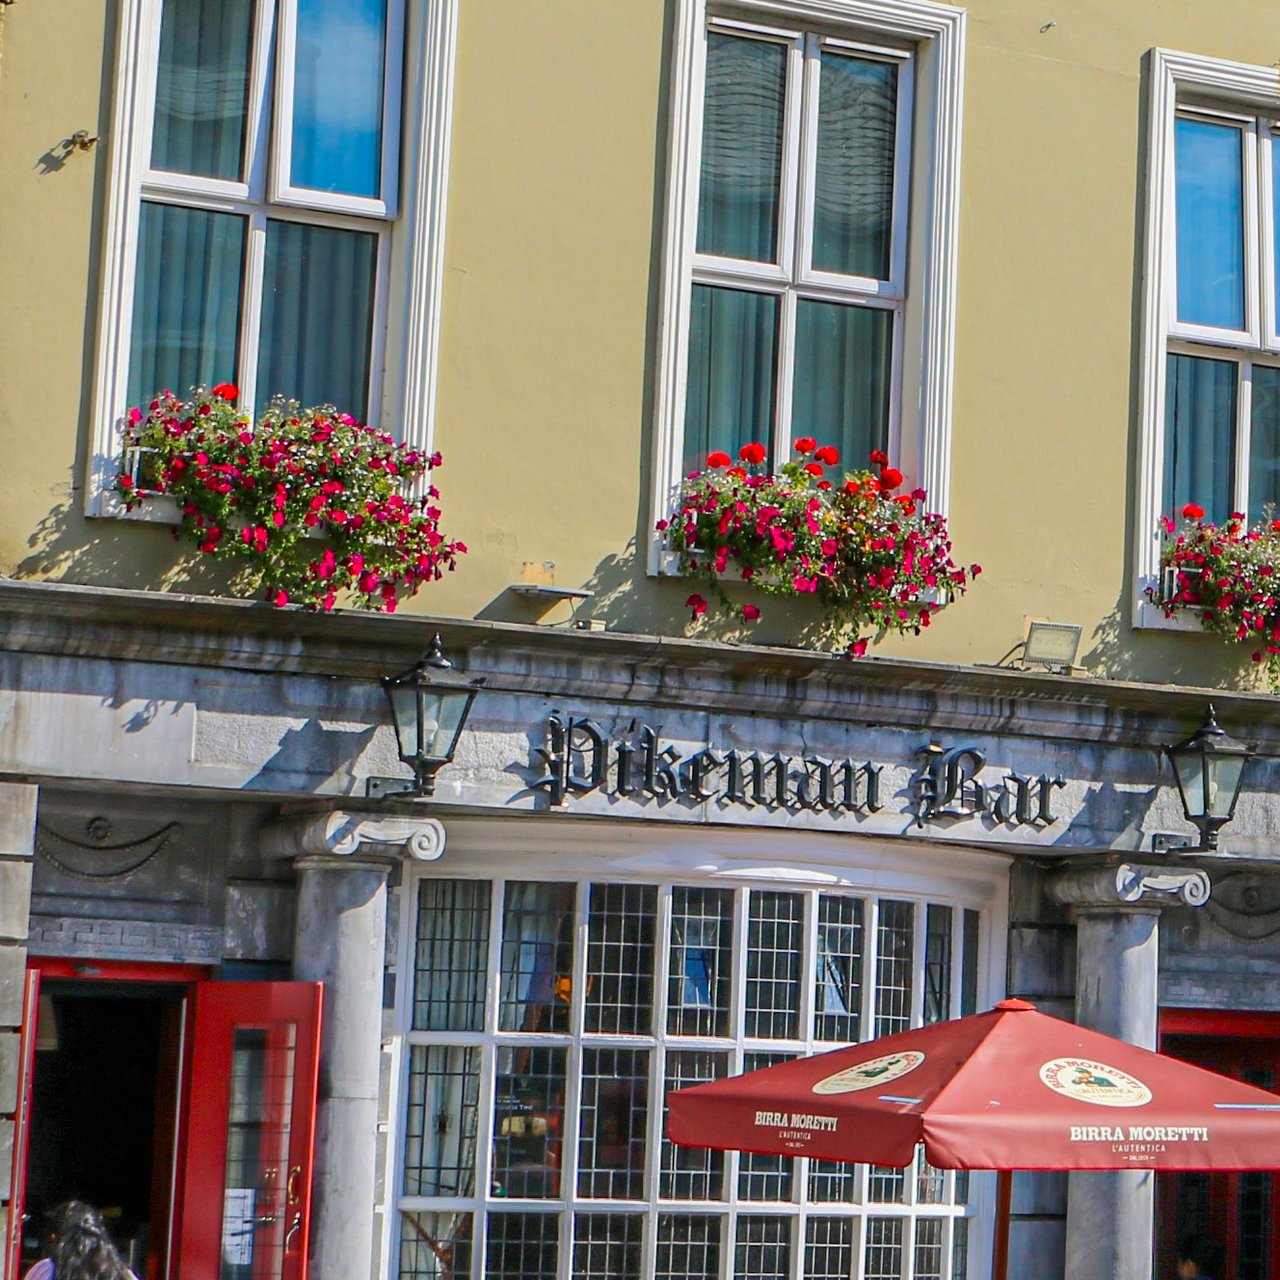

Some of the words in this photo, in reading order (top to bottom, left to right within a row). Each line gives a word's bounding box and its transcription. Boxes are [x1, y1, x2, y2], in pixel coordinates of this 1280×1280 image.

[531, 712, 884, 814] Pikeman
[915, 744, 1067, 829] Bar
[754, 1111, 788, 1127] BIRRA
[790, 1113, 838, 1132] MORETTI
[1070, 1126, 1125, 1141] BIRRA
[1129, 1126, 1209, 1141] MORETTI
[1112, 1144, 1166, 1153] L'AUTENTICA
